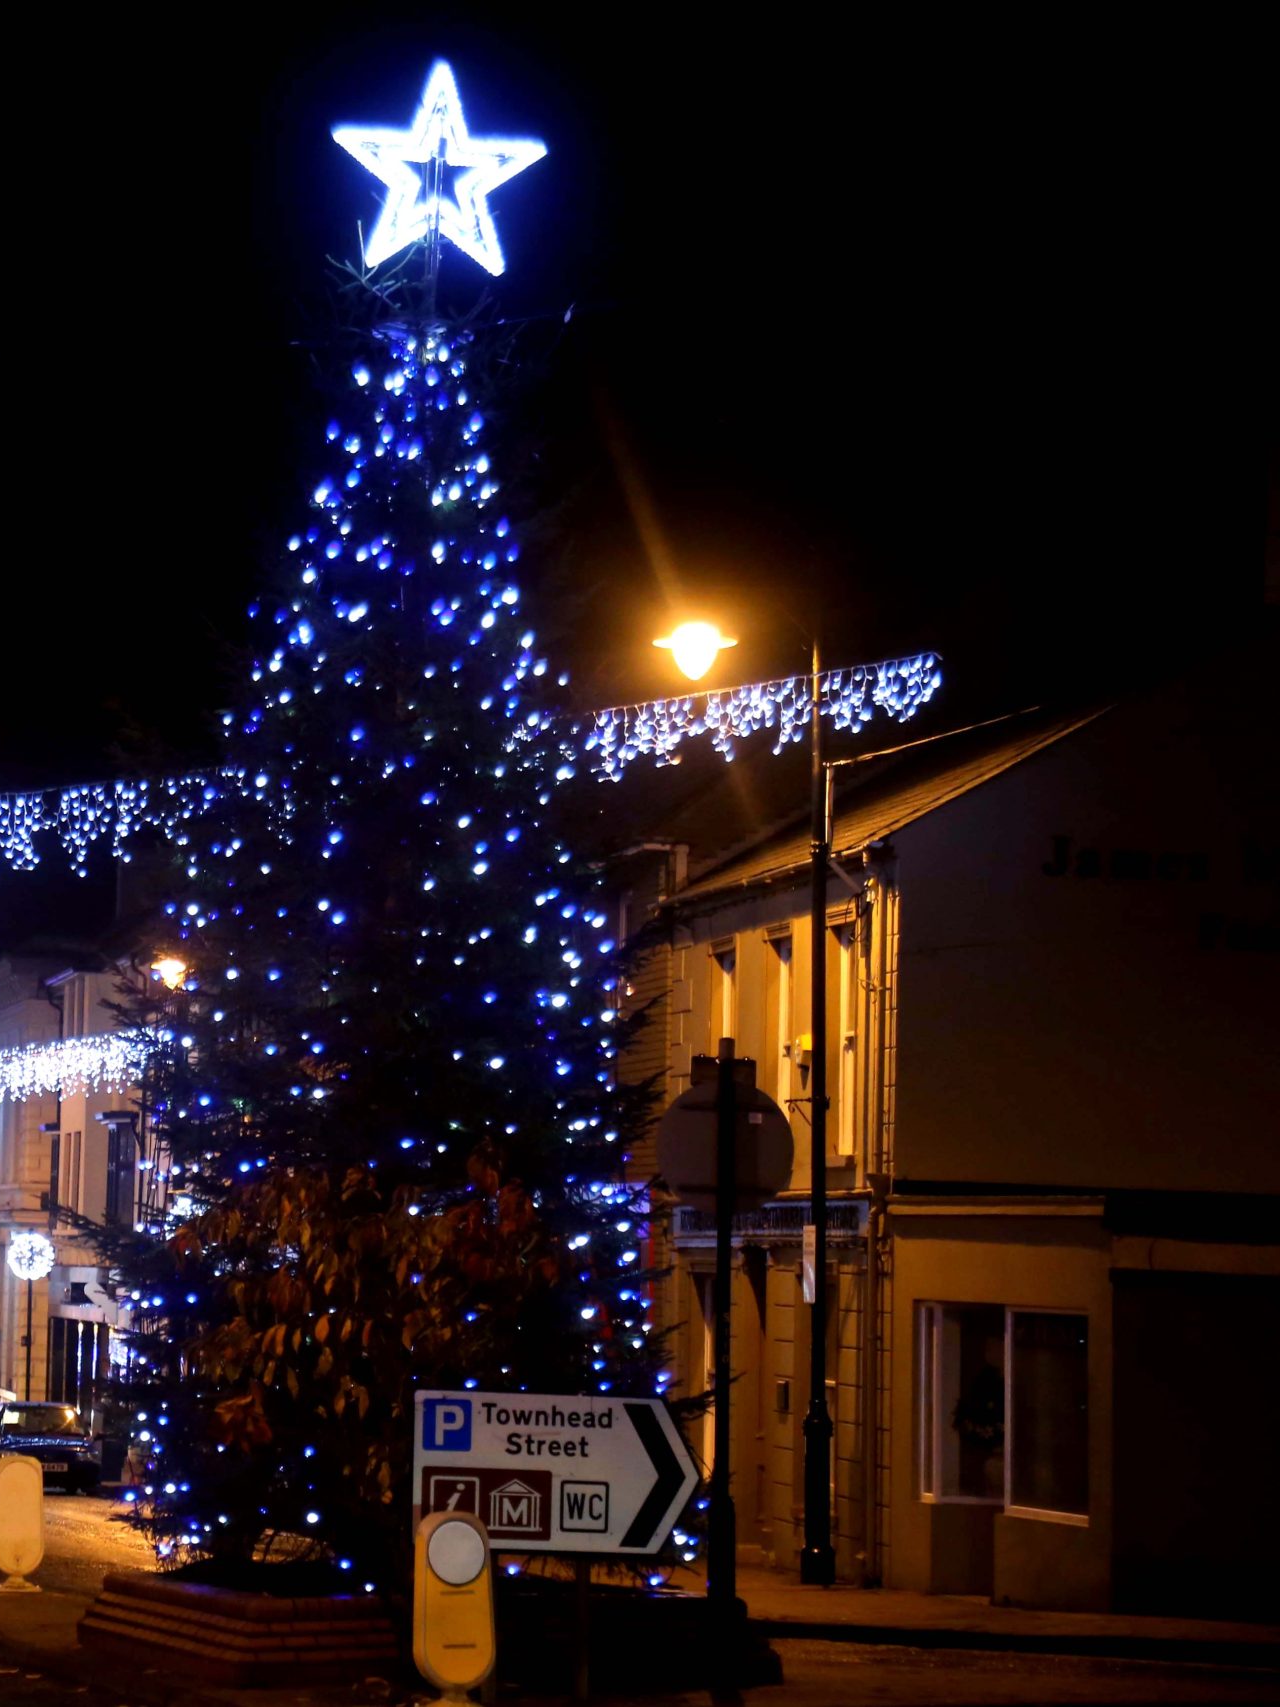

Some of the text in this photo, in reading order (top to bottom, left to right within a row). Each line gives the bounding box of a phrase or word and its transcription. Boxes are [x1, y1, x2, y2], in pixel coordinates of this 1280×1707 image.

[434, 1402, 613, 1447] P Townhead
[505, 1433, 589, 1458] Street
[567, 1493, 604, 1521] WC
